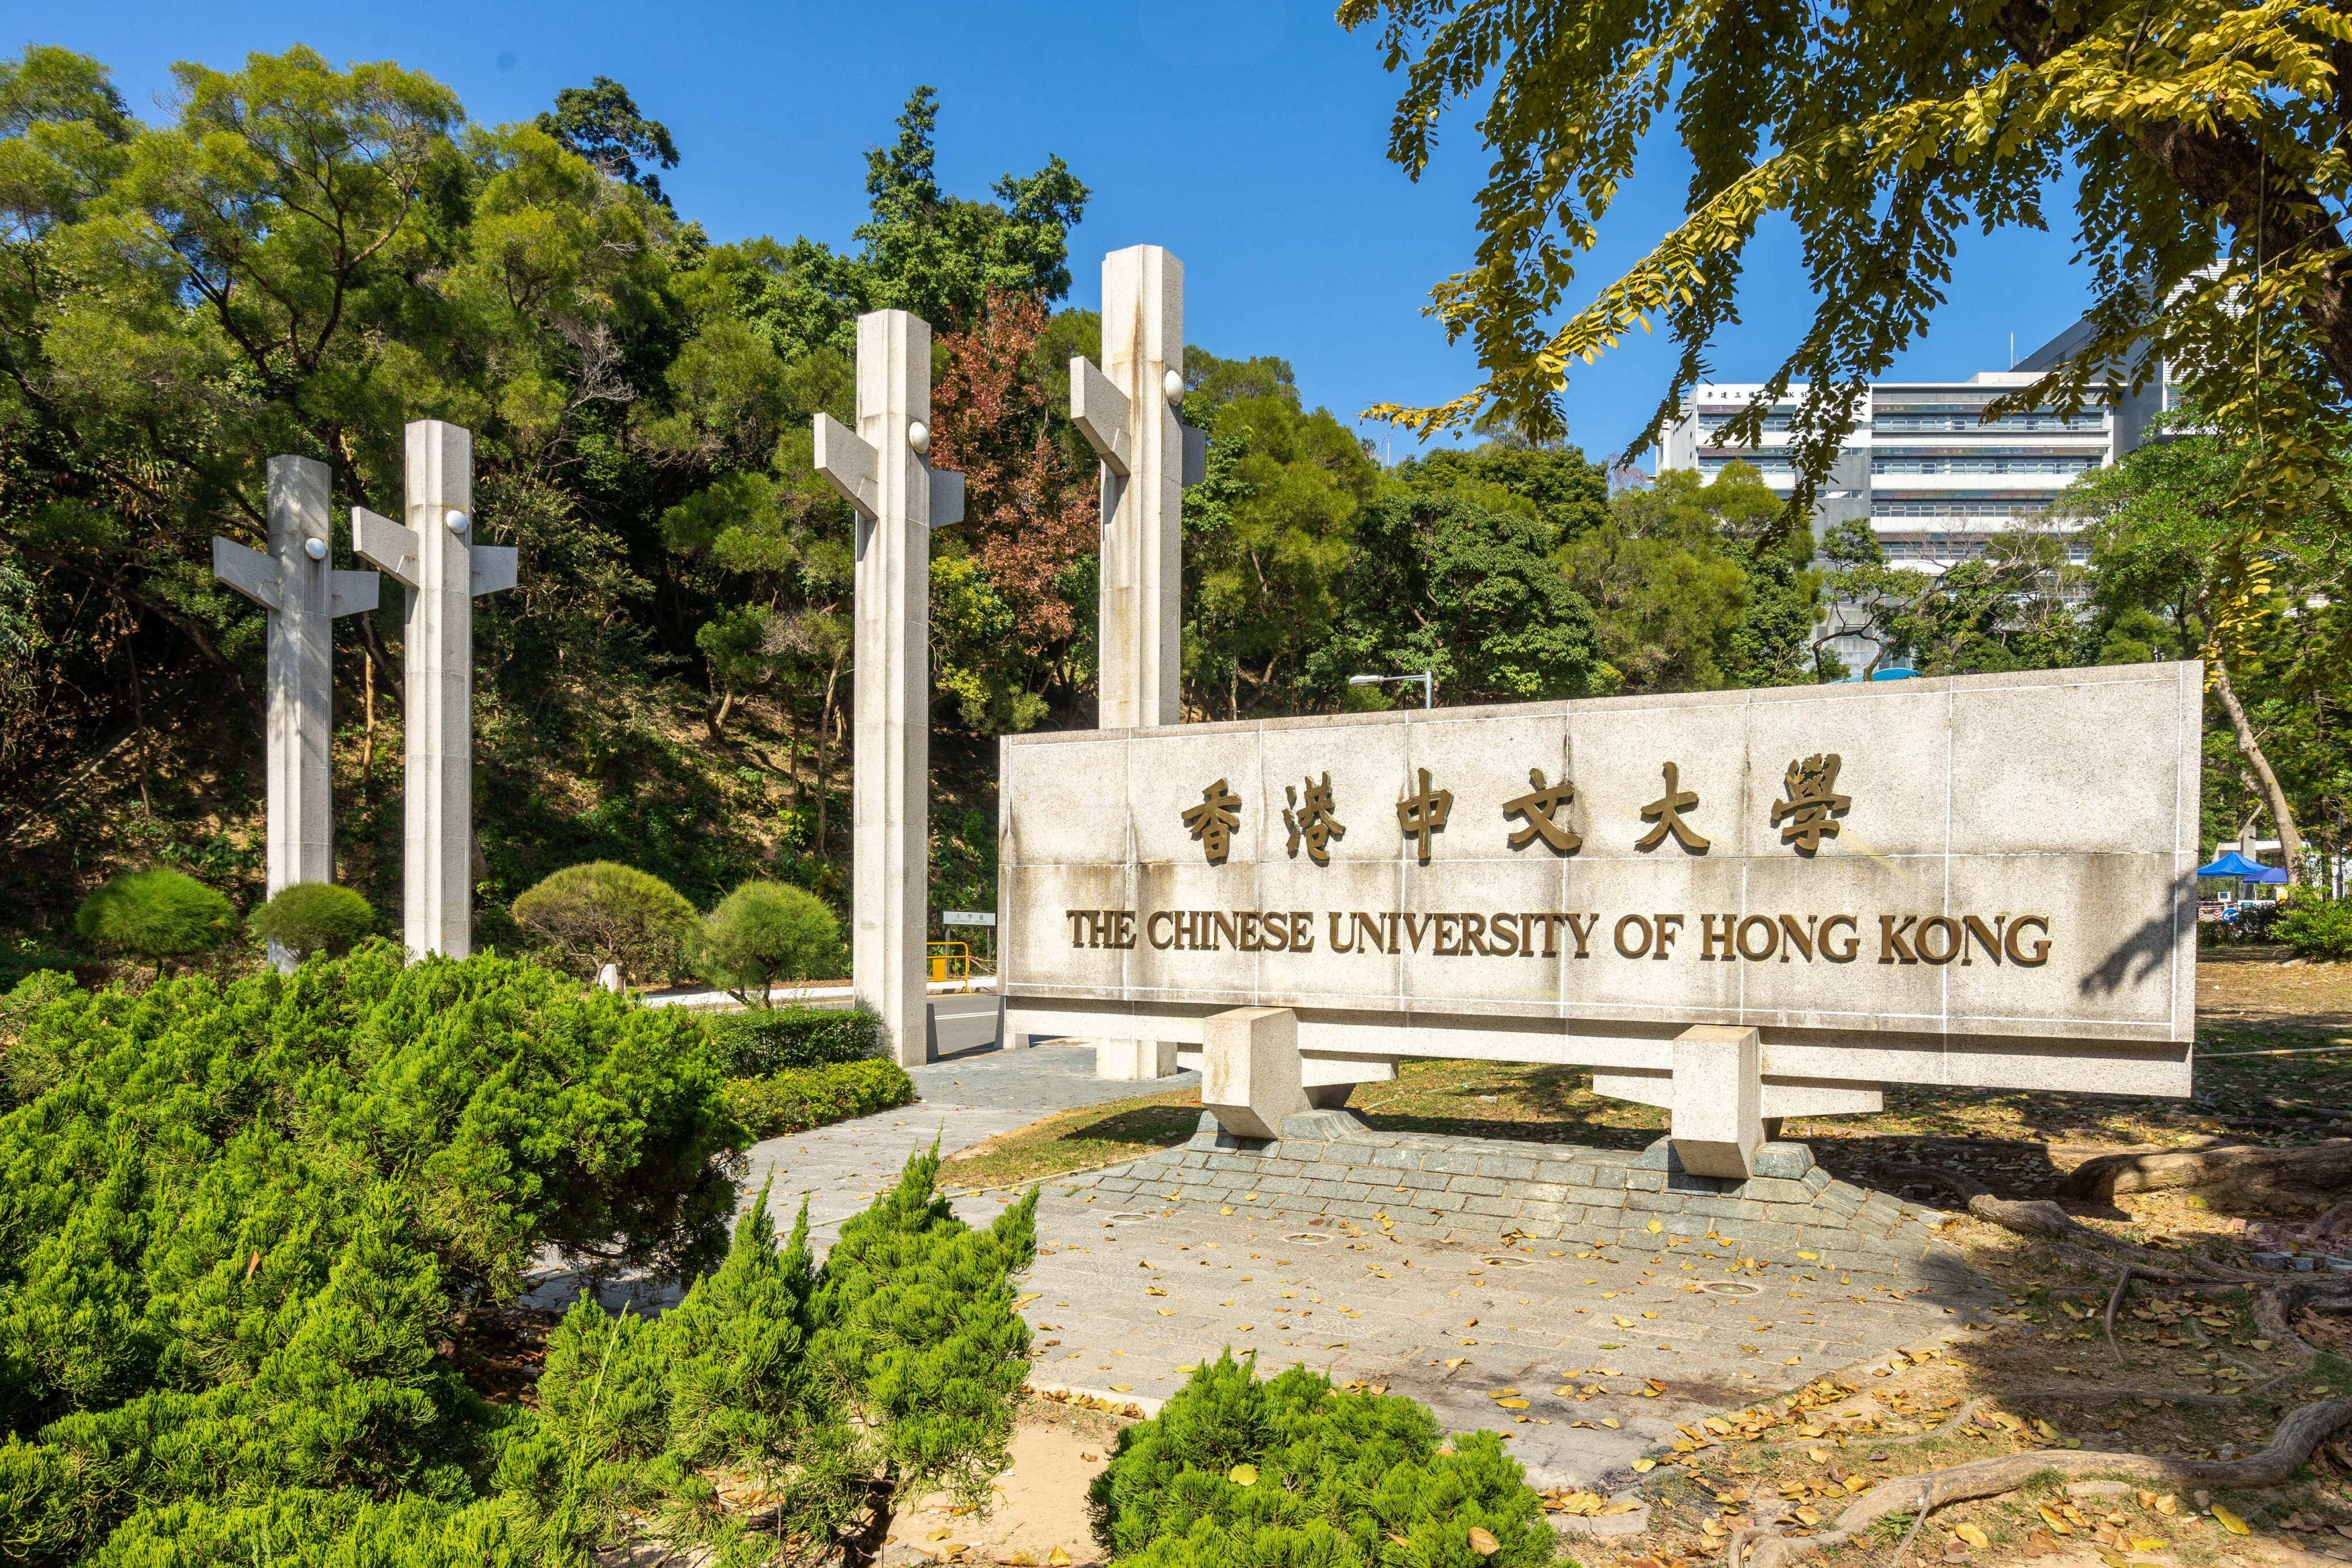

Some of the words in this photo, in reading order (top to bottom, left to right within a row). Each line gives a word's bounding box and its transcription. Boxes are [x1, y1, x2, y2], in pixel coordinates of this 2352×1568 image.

[1180, 752, 1853, 866] 香港中文大學
[1065, 910, 1137, 949] THE
[1148, 910, 1314, 952] CHINESE
[1328, 912, 1599, 959] UNIVERSITY
[1614, 914, 1684, 960] OF
[1700, 914, 1860, 963] HONG
[1878, 915, 2052, 967] KONG
